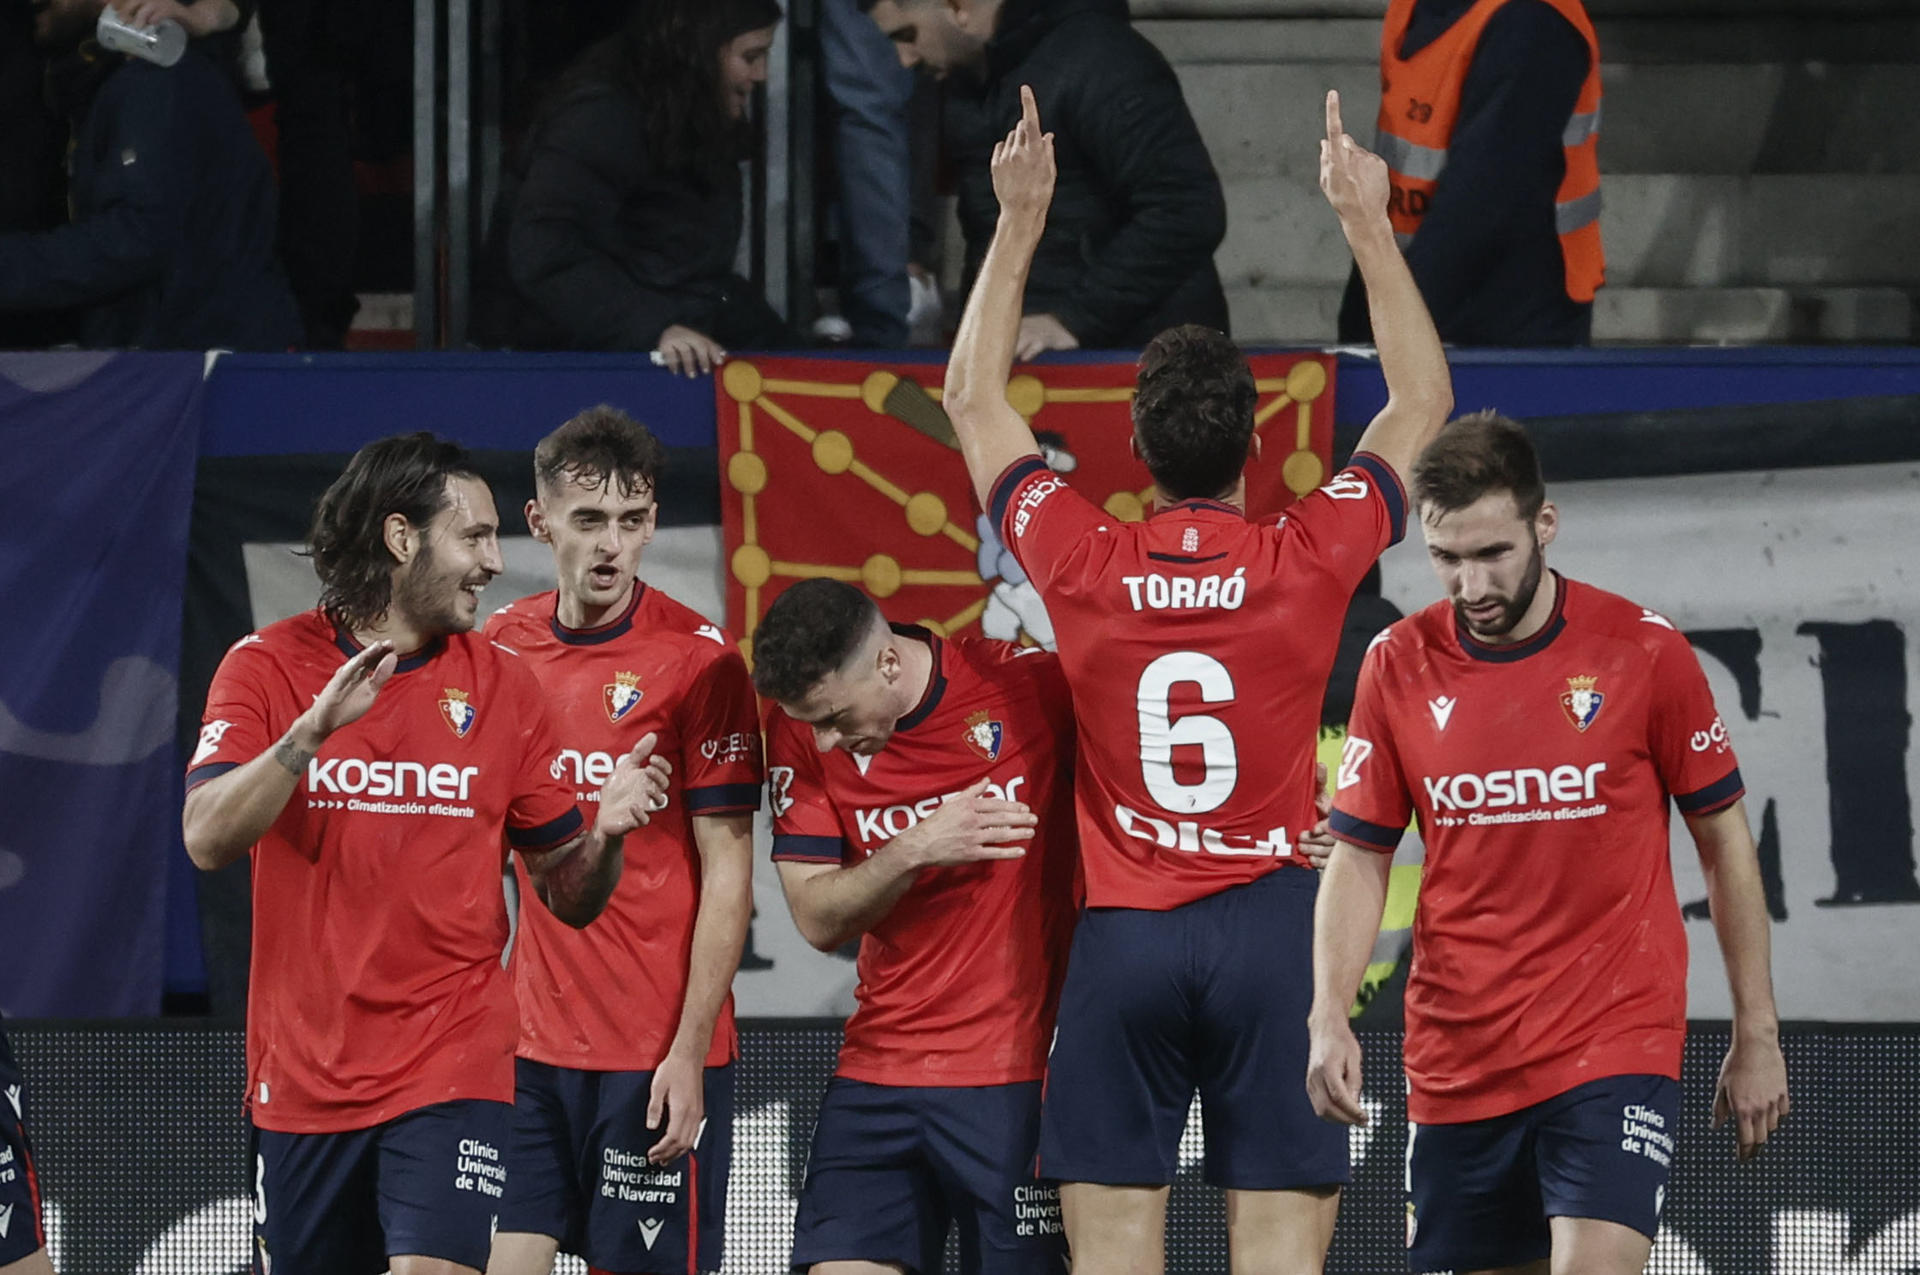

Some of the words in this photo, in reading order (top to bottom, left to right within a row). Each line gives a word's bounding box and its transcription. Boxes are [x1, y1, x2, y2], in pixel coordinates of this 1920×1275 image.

[1122, 567, 1246, 611] TORRÓ
[1137, 650, 1238, 814] 6
[346, 799, 427, 814] Climatización
[428, 803, 475, 818] eficiente
[1468, 809, 1551, 826] Climatización
[1553, 803, 1607, 820] eficiente
[458, 1138, 499, 1161] Clínica
[1621, 1137, 1641, 1153] de
[603, 1147, 647, 1168] Clínica
[455, 1174, 473, 1190] de
[602, 1166, 682, 1187] Universidad
[601, 1184, 616, 1198] de
[618, 1185, 676, 1204] Navarra
[1016, 1220, 1034, 1236] de
